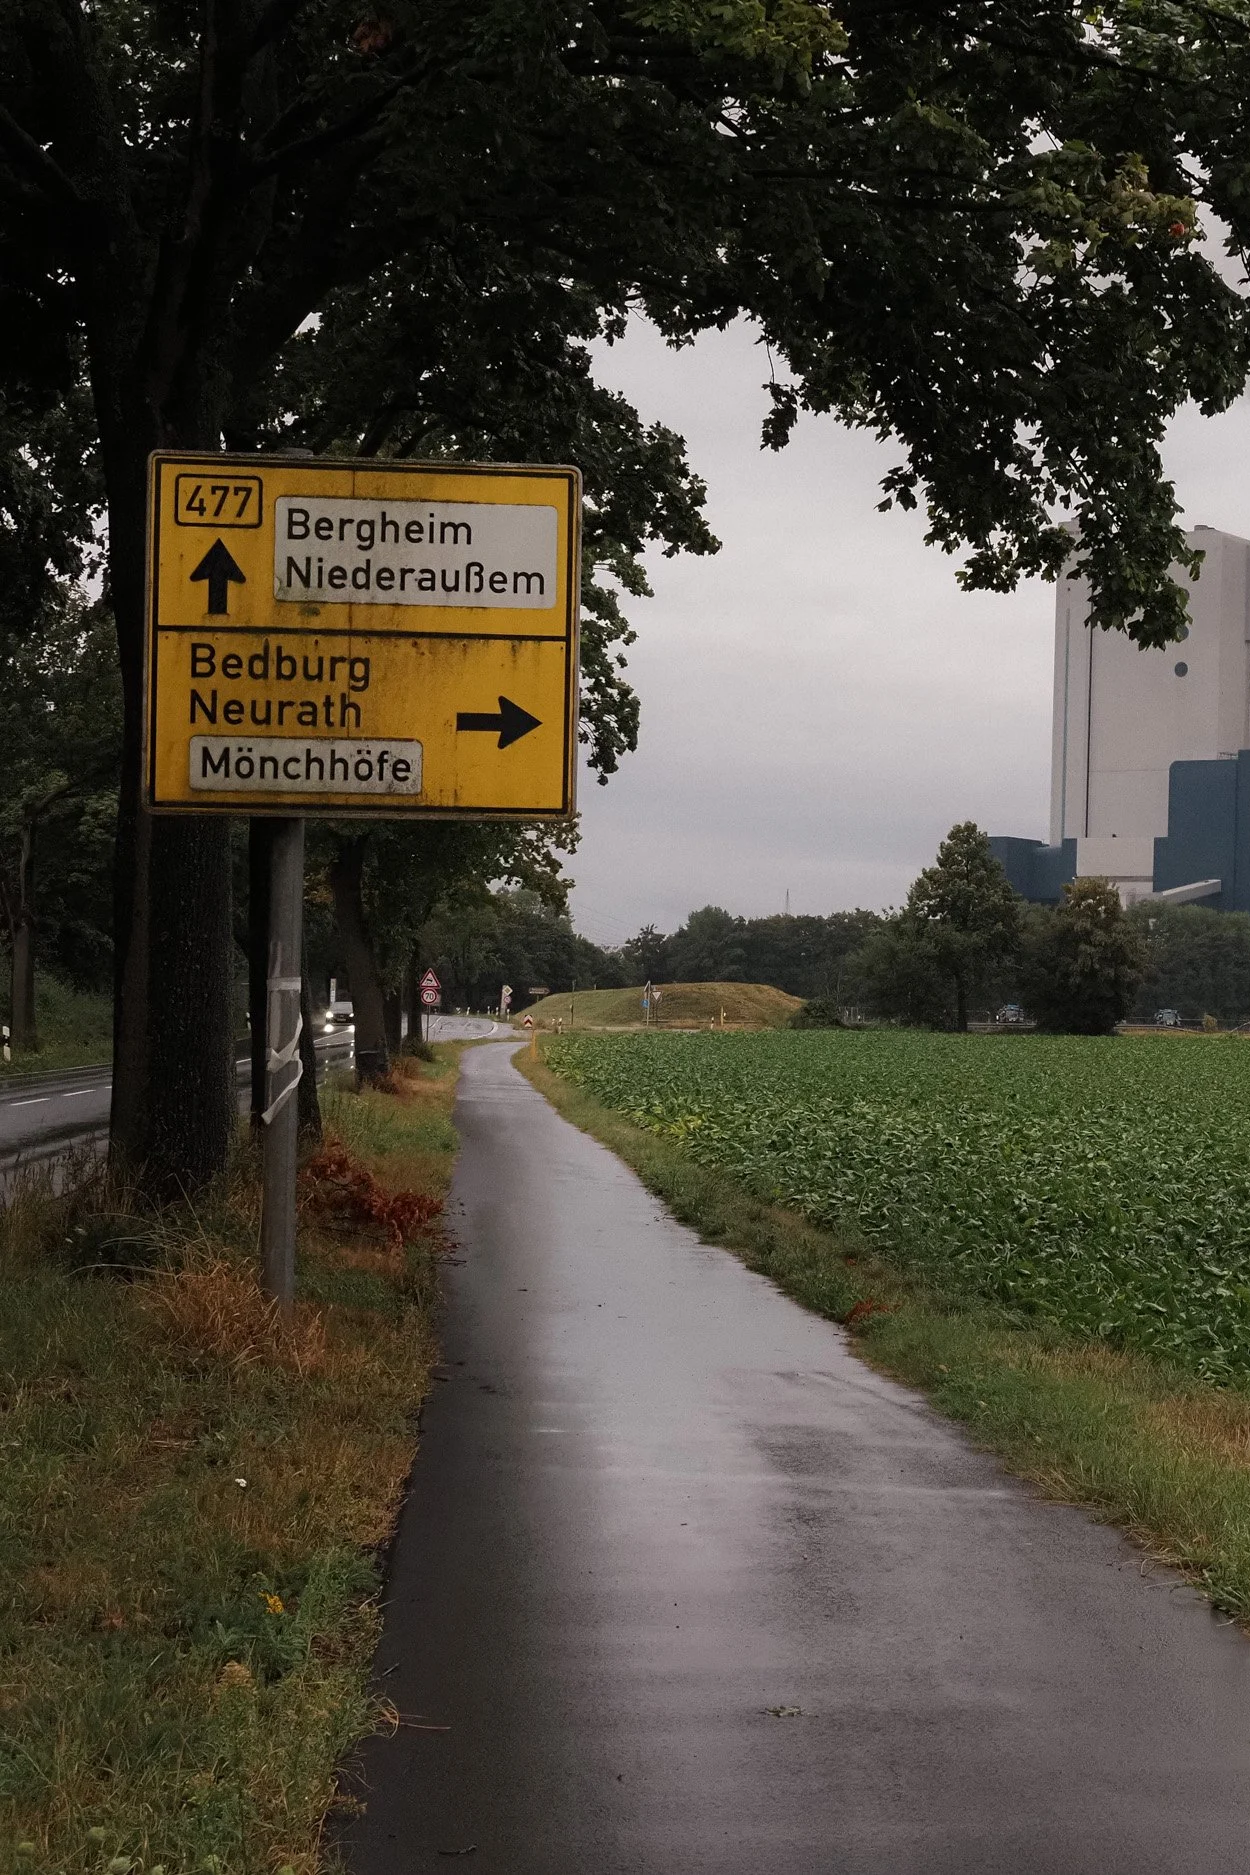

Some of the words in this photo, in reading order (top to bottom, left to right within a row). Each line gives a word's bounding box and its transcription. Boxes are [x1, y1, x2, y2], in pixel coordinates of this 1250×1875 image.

[185, 484, 253, 518] 477
[287, 507, 472, 552] Bergheim
[285, 555, 545, 595] Niederaußem
[190, 642, 371, 693] Bedburg
[189, 688, 361, 729] Neurath
[201, 746, 412, 783] Mönchhöfe
